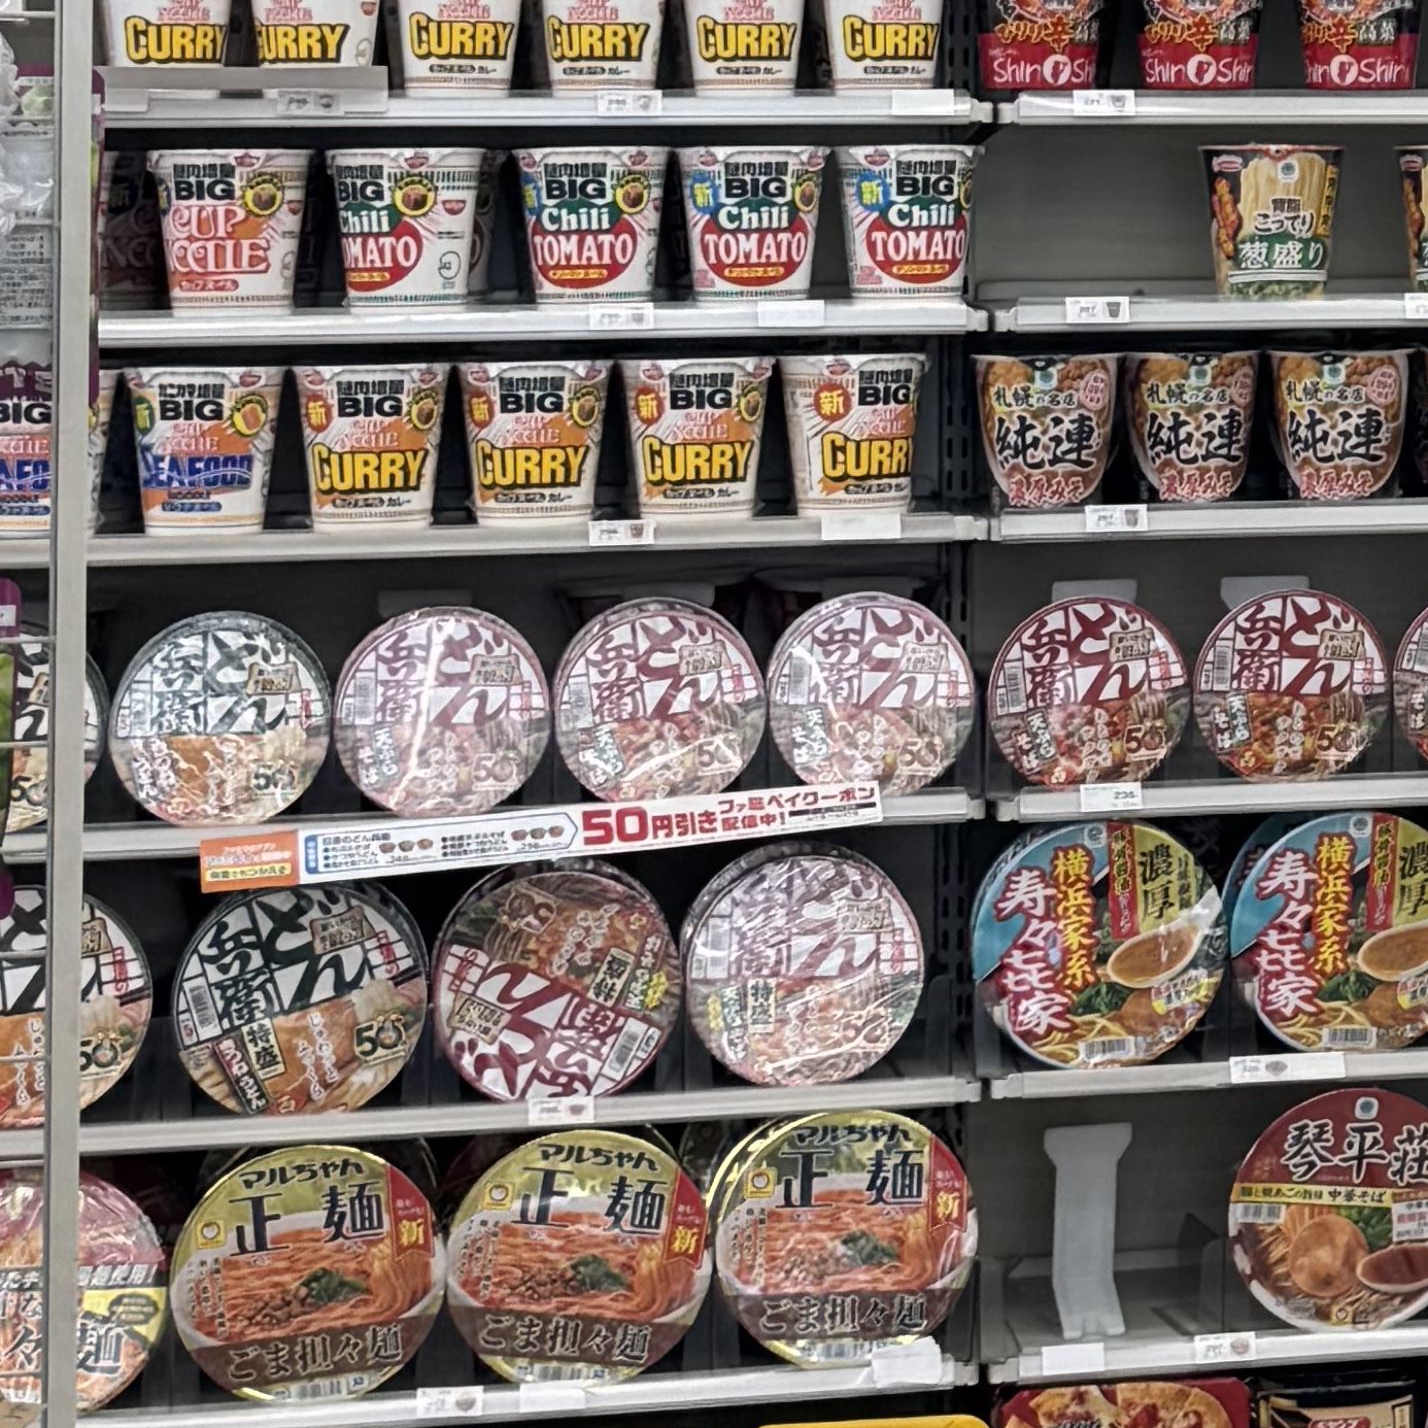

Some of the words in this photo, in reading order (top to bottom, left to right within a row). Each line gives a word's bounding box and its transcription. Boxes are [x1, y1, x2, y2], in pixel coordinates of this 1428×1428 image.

[697, 15, 796, 61] CURRY
[173, 174, 236, 202] BIG
[544, 174, 607, 201] BIG
[724, 175, 787, 200] BIG
[540, 206, 609, 232] Chili
[716, 204, 789, 230] Chili
[886, 203, 956, 229] Chili
[531, 232, 637, 268] TOMATO
[703, 229, 808, 264] TOMATO
[870, 229, 965, 262] TOMATO
[336, 395, 403, 418] BIG
[668, 388, 732, 411] BIG
[995, 412, 1096, 471] 純連
[1287, 407, 1385, 464] 純連
[313, 445, 426, 494] CURRY
[477, 444, 589, 489] CURRY
[643, 436, 750, 483] CURRY
[1139, 850, 1175, 921] 濃厚
[1316, 835, 1354, 972] 横浜家系
[1054, 846, 1096, 988] 横浜家系
[246, 1027, 280, 1071] 特盛
[794, 1122, 914, 1148] マルちゃん
[239, 1157, 364, 1190] マルちゃん
[537, 1142, 657, 1170] マルちゃん
[778, 1147, 925, 1211] 正麺
[229, 1181, 387, 1259] 正麺
[517, 1170, 668, 1237] 正麺
[934, 1192, 961, 1219] 新
[400, 1218, 425, 1248] 新
[760, 1293, 928, 1334] ごま担々麺
[227, 1324, 403, 1383] ごま担々麺
[477, 1312, 653, 1364] ごま担々麺
